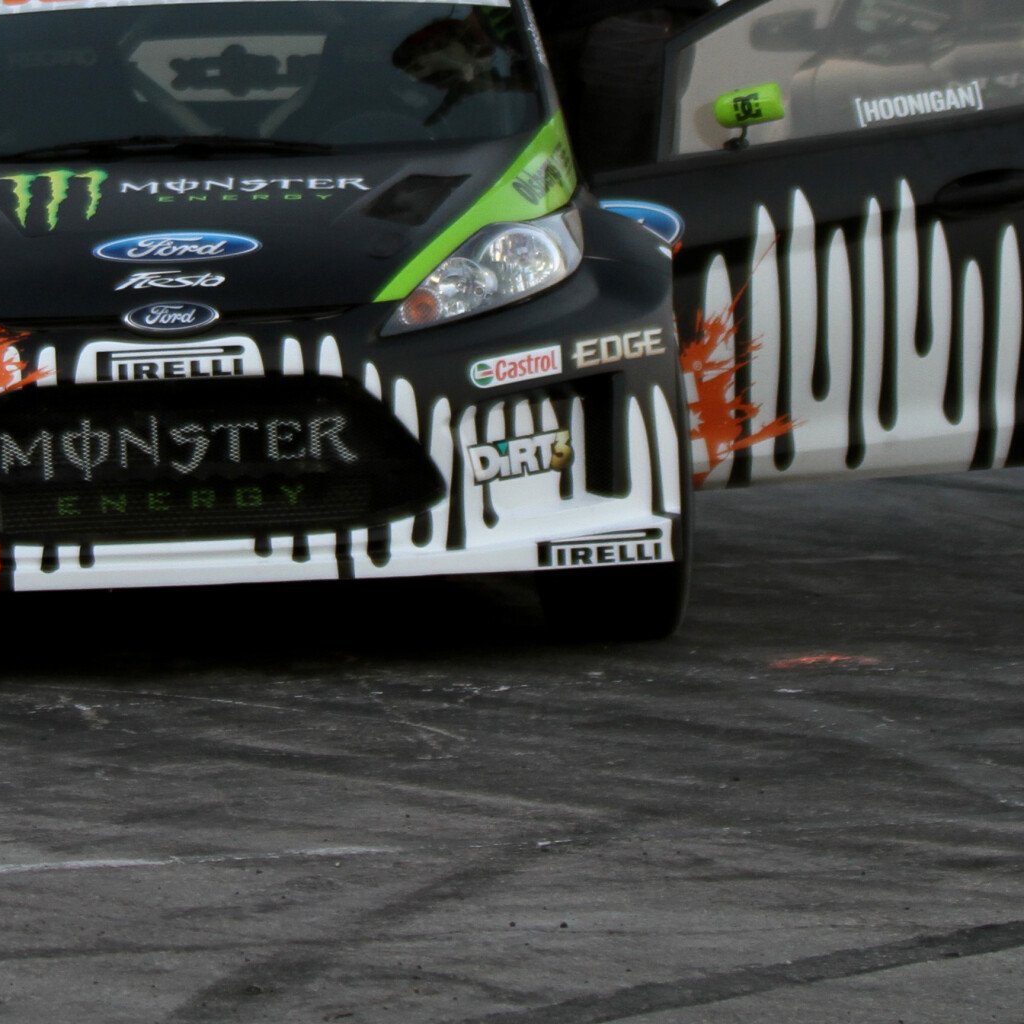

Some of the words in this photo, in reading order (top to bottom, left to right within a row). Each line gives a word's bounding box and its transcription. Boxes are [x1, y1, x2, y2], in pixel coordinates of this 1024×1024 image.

[119, 175, 371, 195] MONSTER
[157, 192, 334, 203] ENERGY
[126, 234, 227, 259] Ford
[114, 269, 226, 291] Fiesta
[144, 305, 196, 325] Ford
[95, 344, 245, 381] PIRELLI
[494, 350, 558, 381] Castrol
[571, 328, 666, 368] EDGE
[56, 484, 305, 517] ENERGY
[537, 528, 663, 567] PIRELLI
